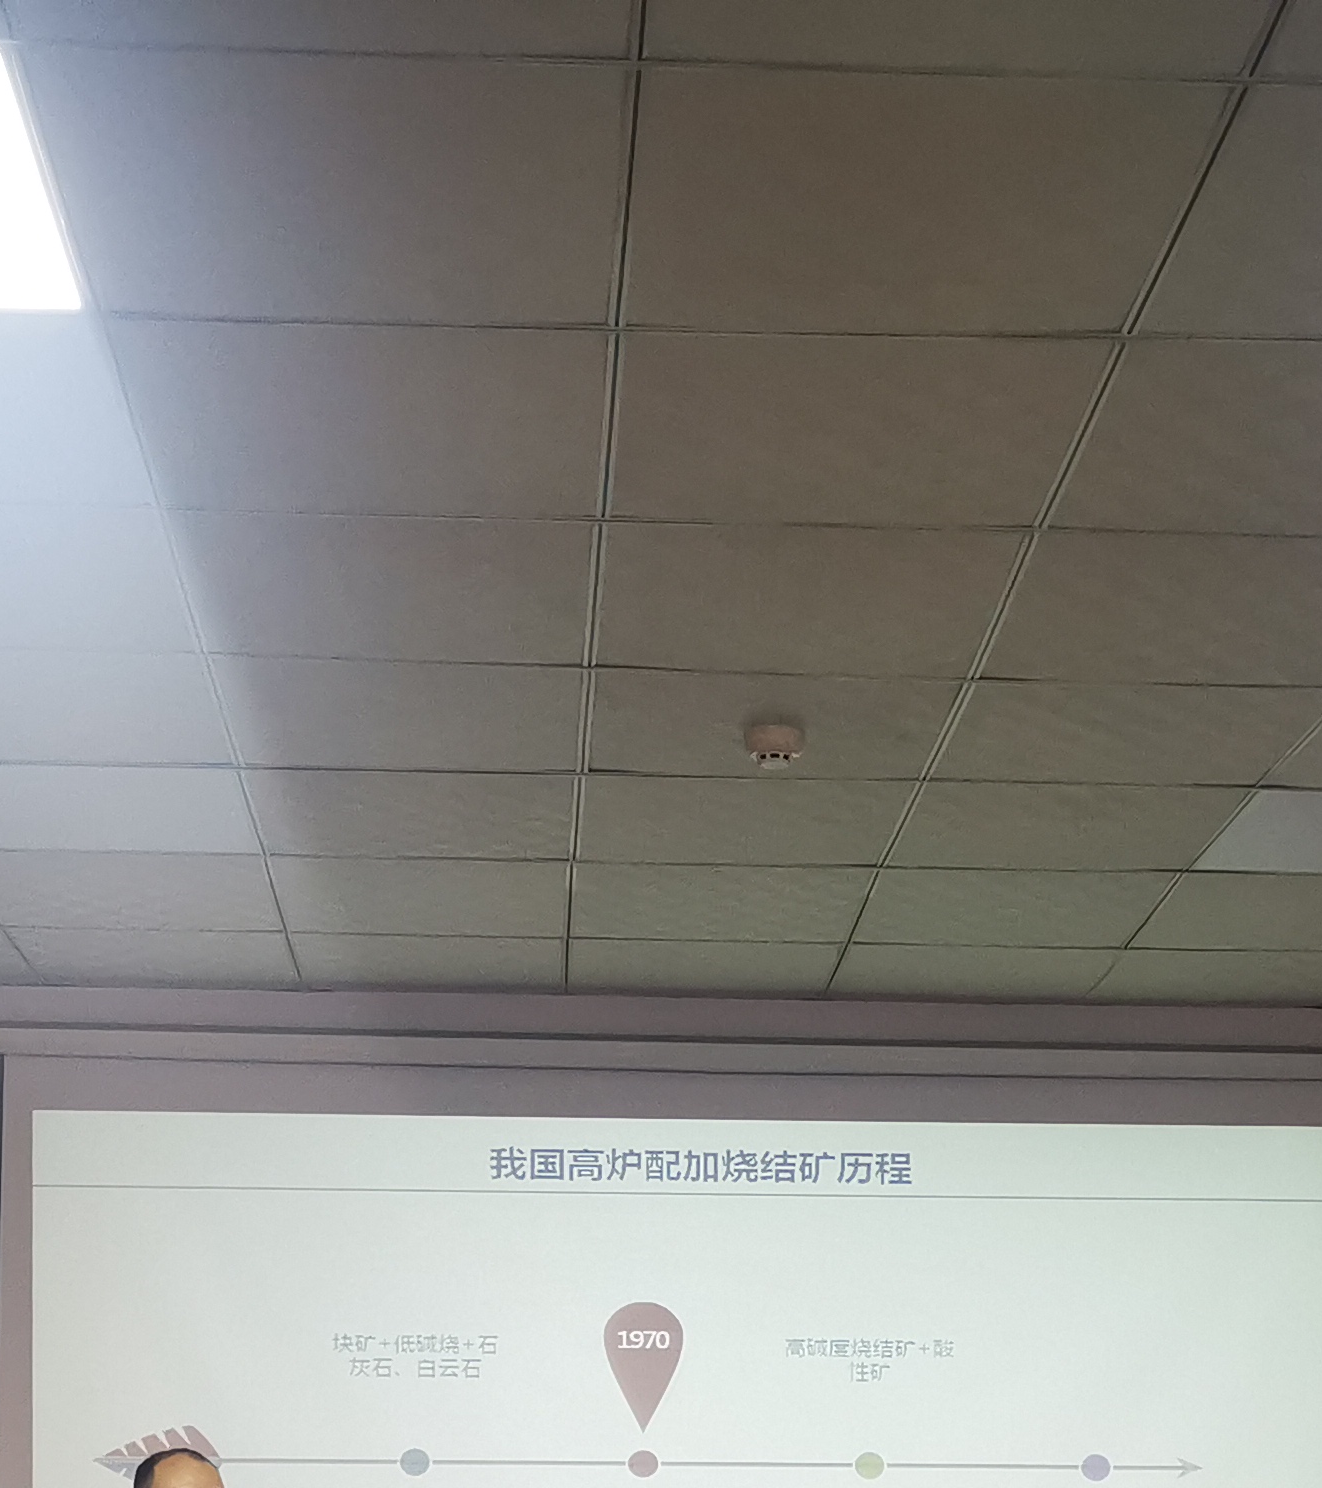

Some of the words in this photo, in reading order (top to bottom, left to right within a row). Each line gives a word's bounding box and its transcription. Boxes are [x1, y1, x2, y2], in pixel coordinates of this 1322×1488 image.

[489, 1146, 914, 1185] 我国高炉配加烧结矿历程
[617, 1330, 670, 1349] 1970
[349, 1357, 482, 1378] 灰石、白云石
[849, 1361, 891, 1382] 性矿
